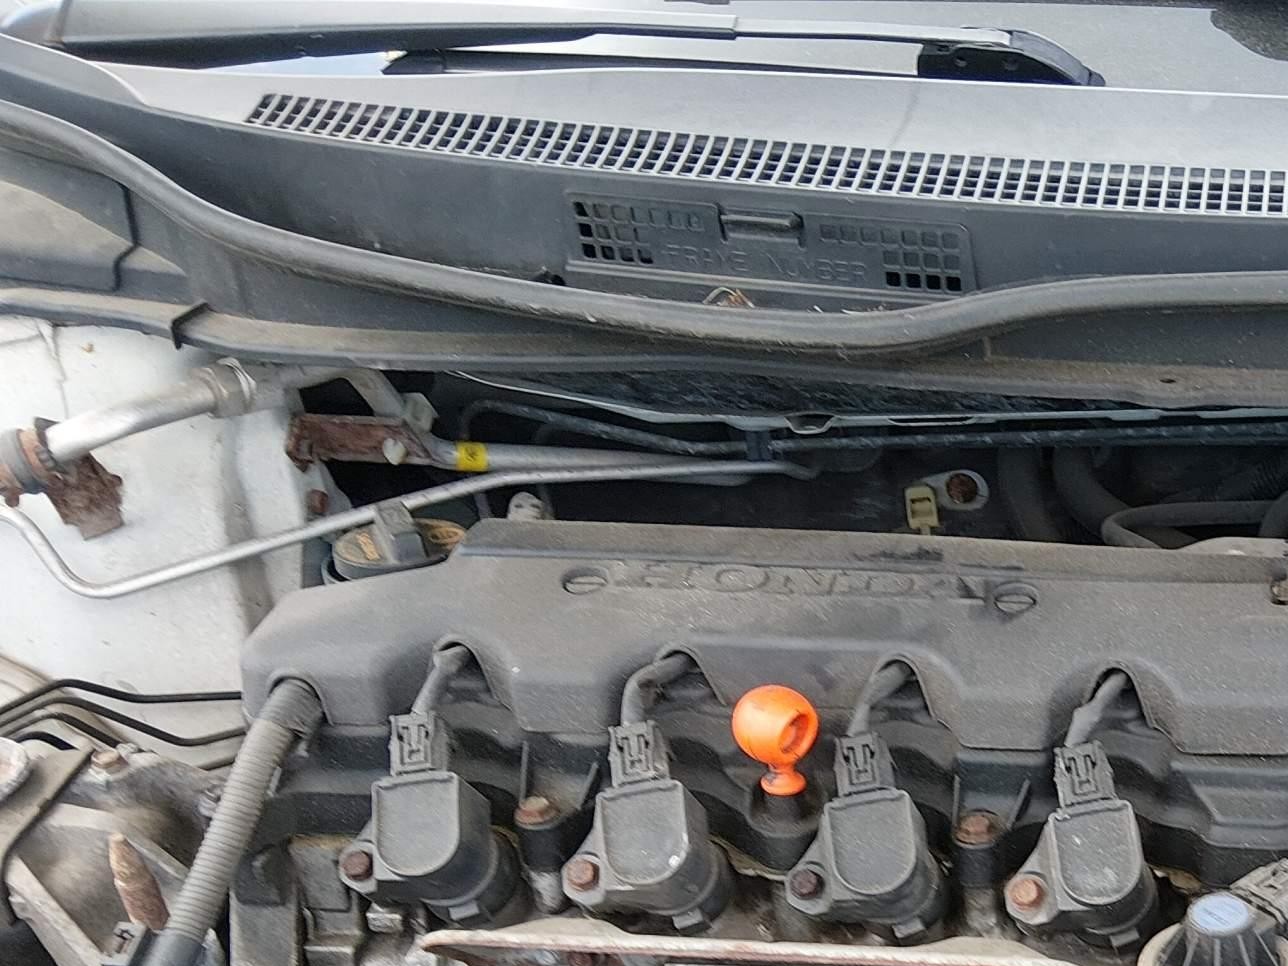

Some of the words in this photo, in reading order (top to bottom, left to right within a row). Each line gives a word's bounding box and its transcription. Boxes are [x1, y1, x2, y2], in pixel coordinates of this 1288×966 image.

[662, 242, 748, 274] FRAME
[762, 247, 867, 284] NUMBER
[632, 562, 988, 600] HONDA
